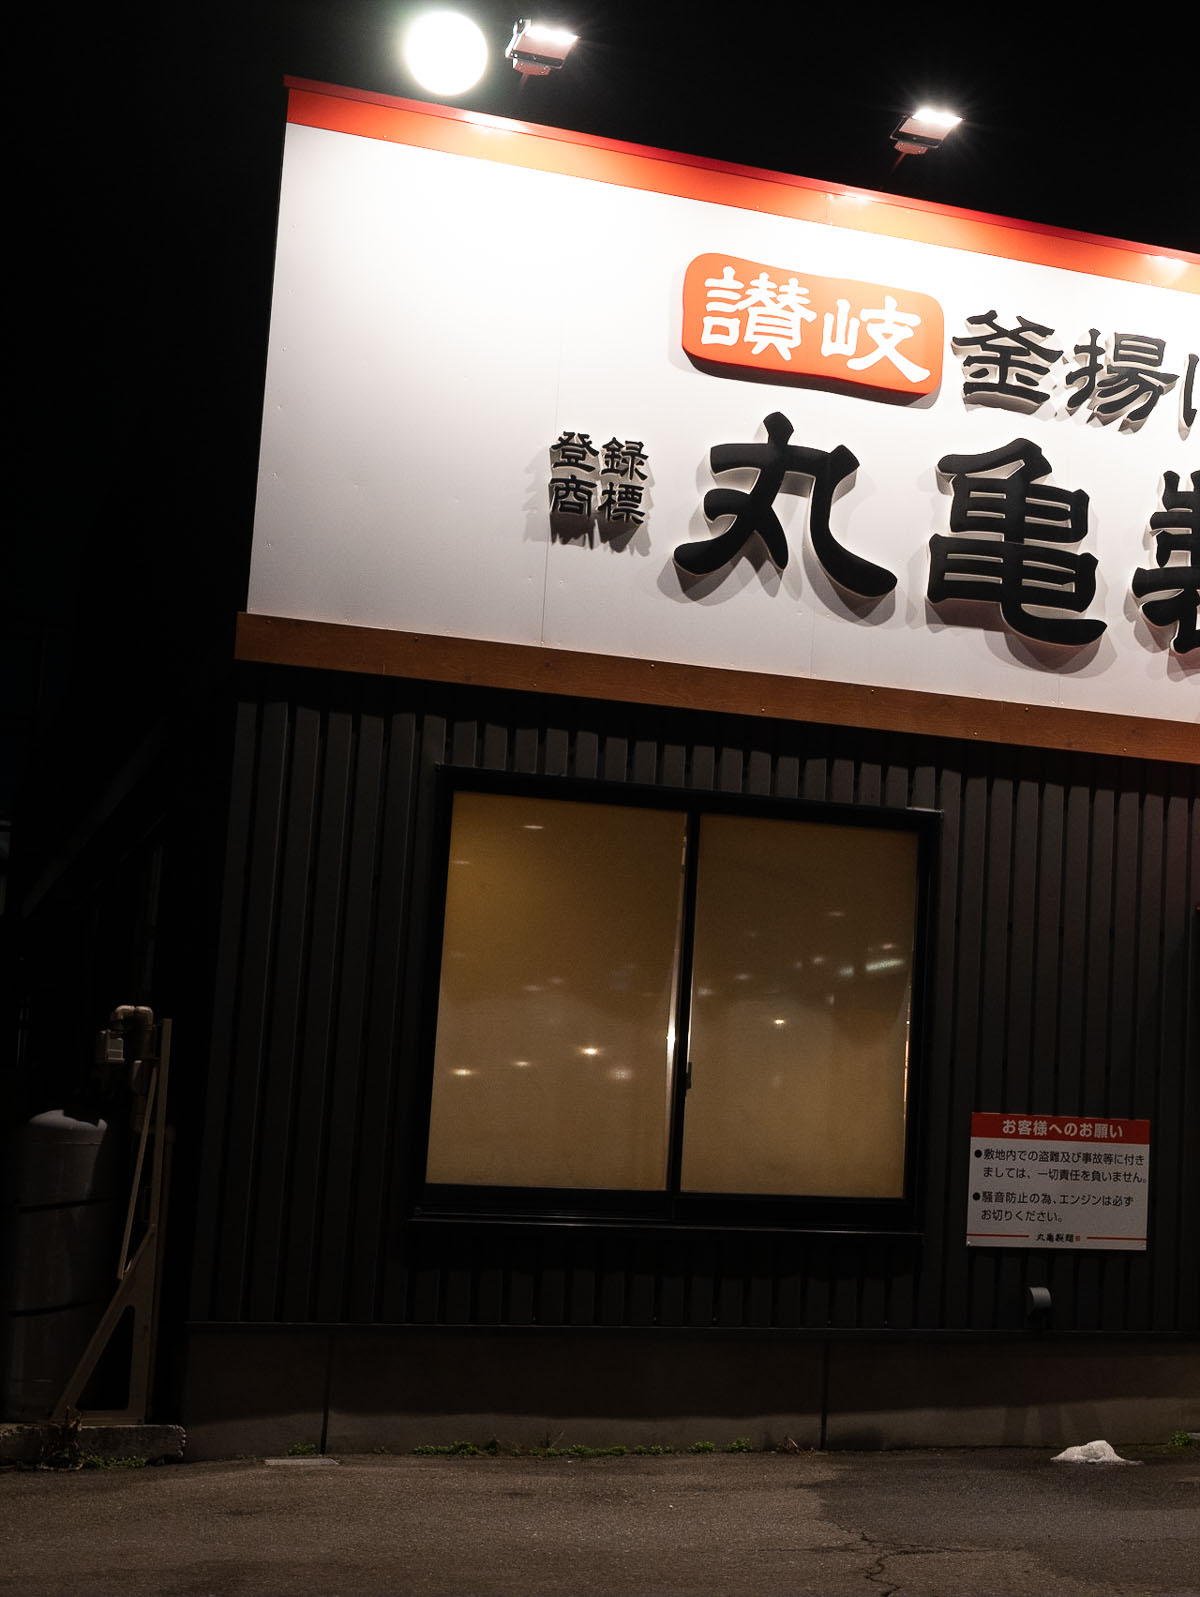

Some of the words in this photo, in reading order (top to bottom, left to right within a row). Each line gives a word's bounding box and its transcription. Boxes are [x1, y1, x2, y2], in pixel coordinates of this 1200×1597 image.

[700, 265, 931, 384] 讃岐
[549, 431, 649, 481] 登録
[548, 473, 645, 525] 商標
[1002, 1119, 1124, 1139] お客様へのお願い
[983, 1148, 1145, 1167] 敷地内での盗難及び事故等に付き
[983, 1166, 1147, 1184] ましては、一切責任を負いません。
[981, 1209, 1063, 1223] お切りください。
